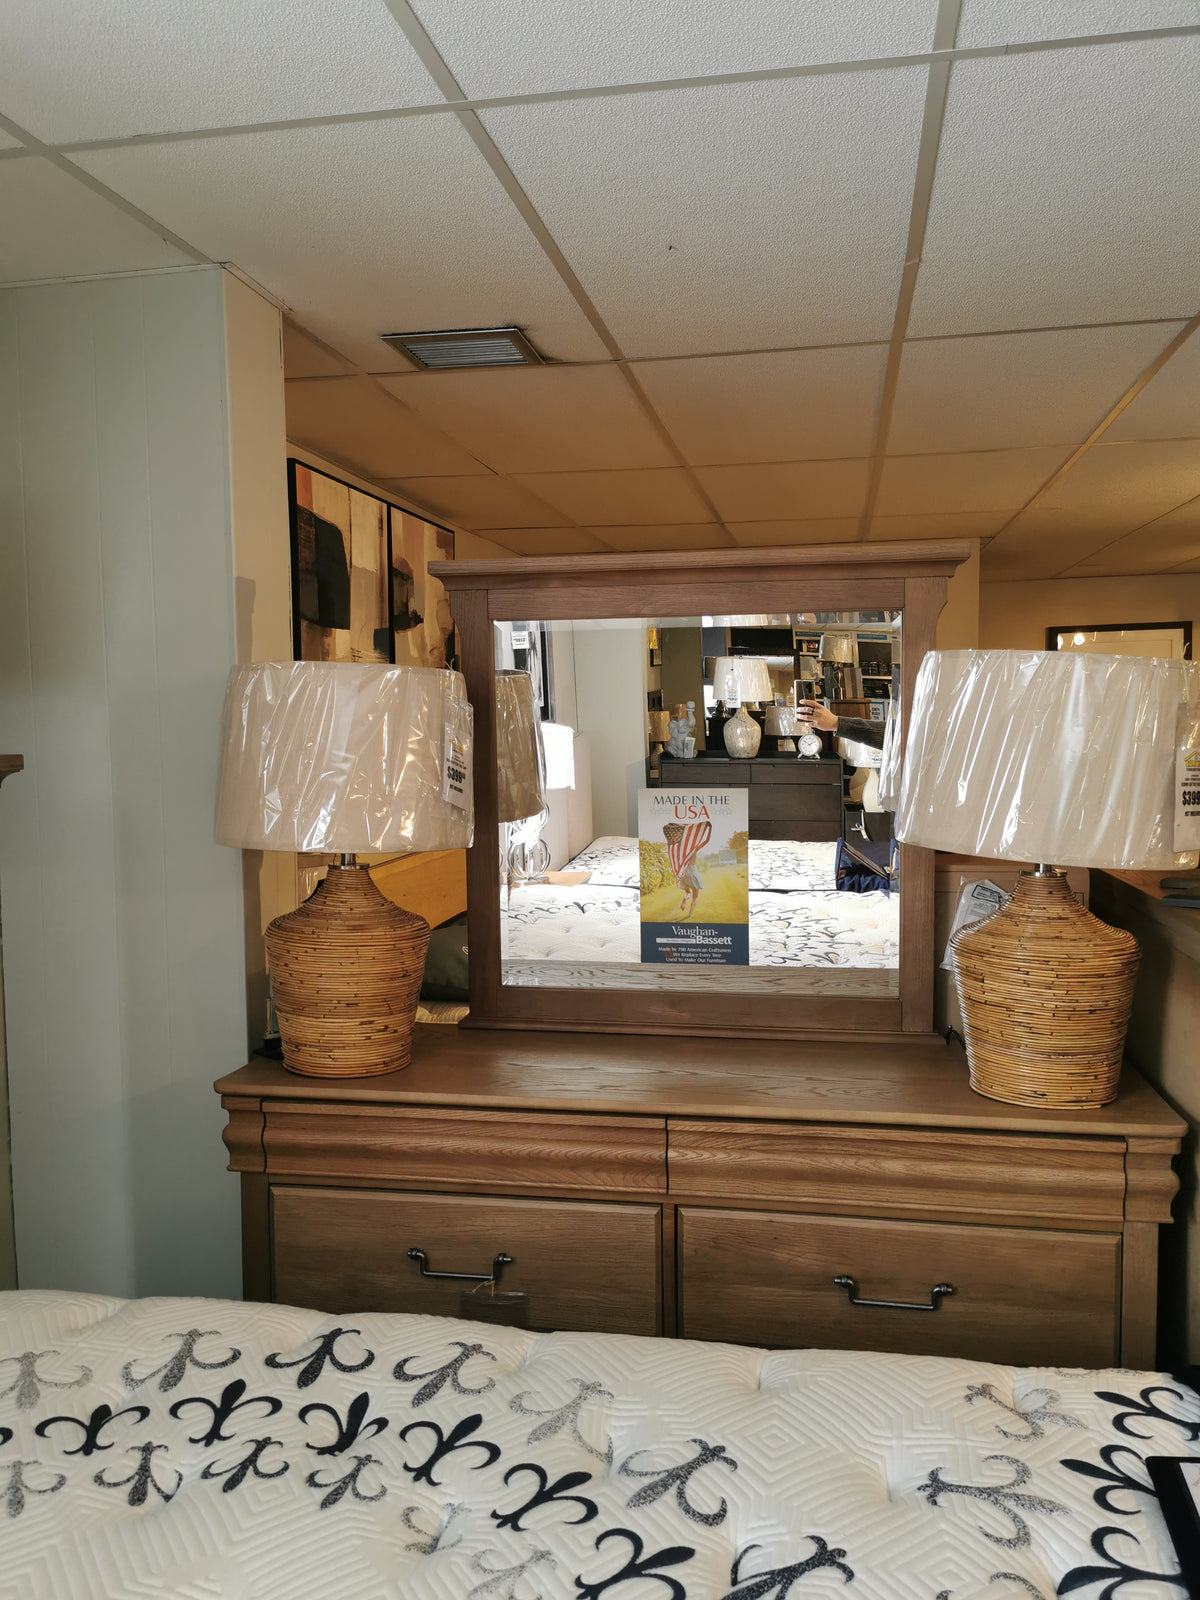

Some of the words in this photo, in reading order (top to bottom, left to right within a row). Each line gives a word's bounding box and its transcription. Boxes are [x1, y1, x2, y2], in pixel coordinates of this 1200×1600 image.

[653, 795, 687, 805] MADE
[691, 795, 704, 805] IN
[708, 795, 730, 805] THE
[674, 805, 710, 820] USA
[671, 925, 718, 938] Vaughan-
[696, 935, 732, 945] Bassett
